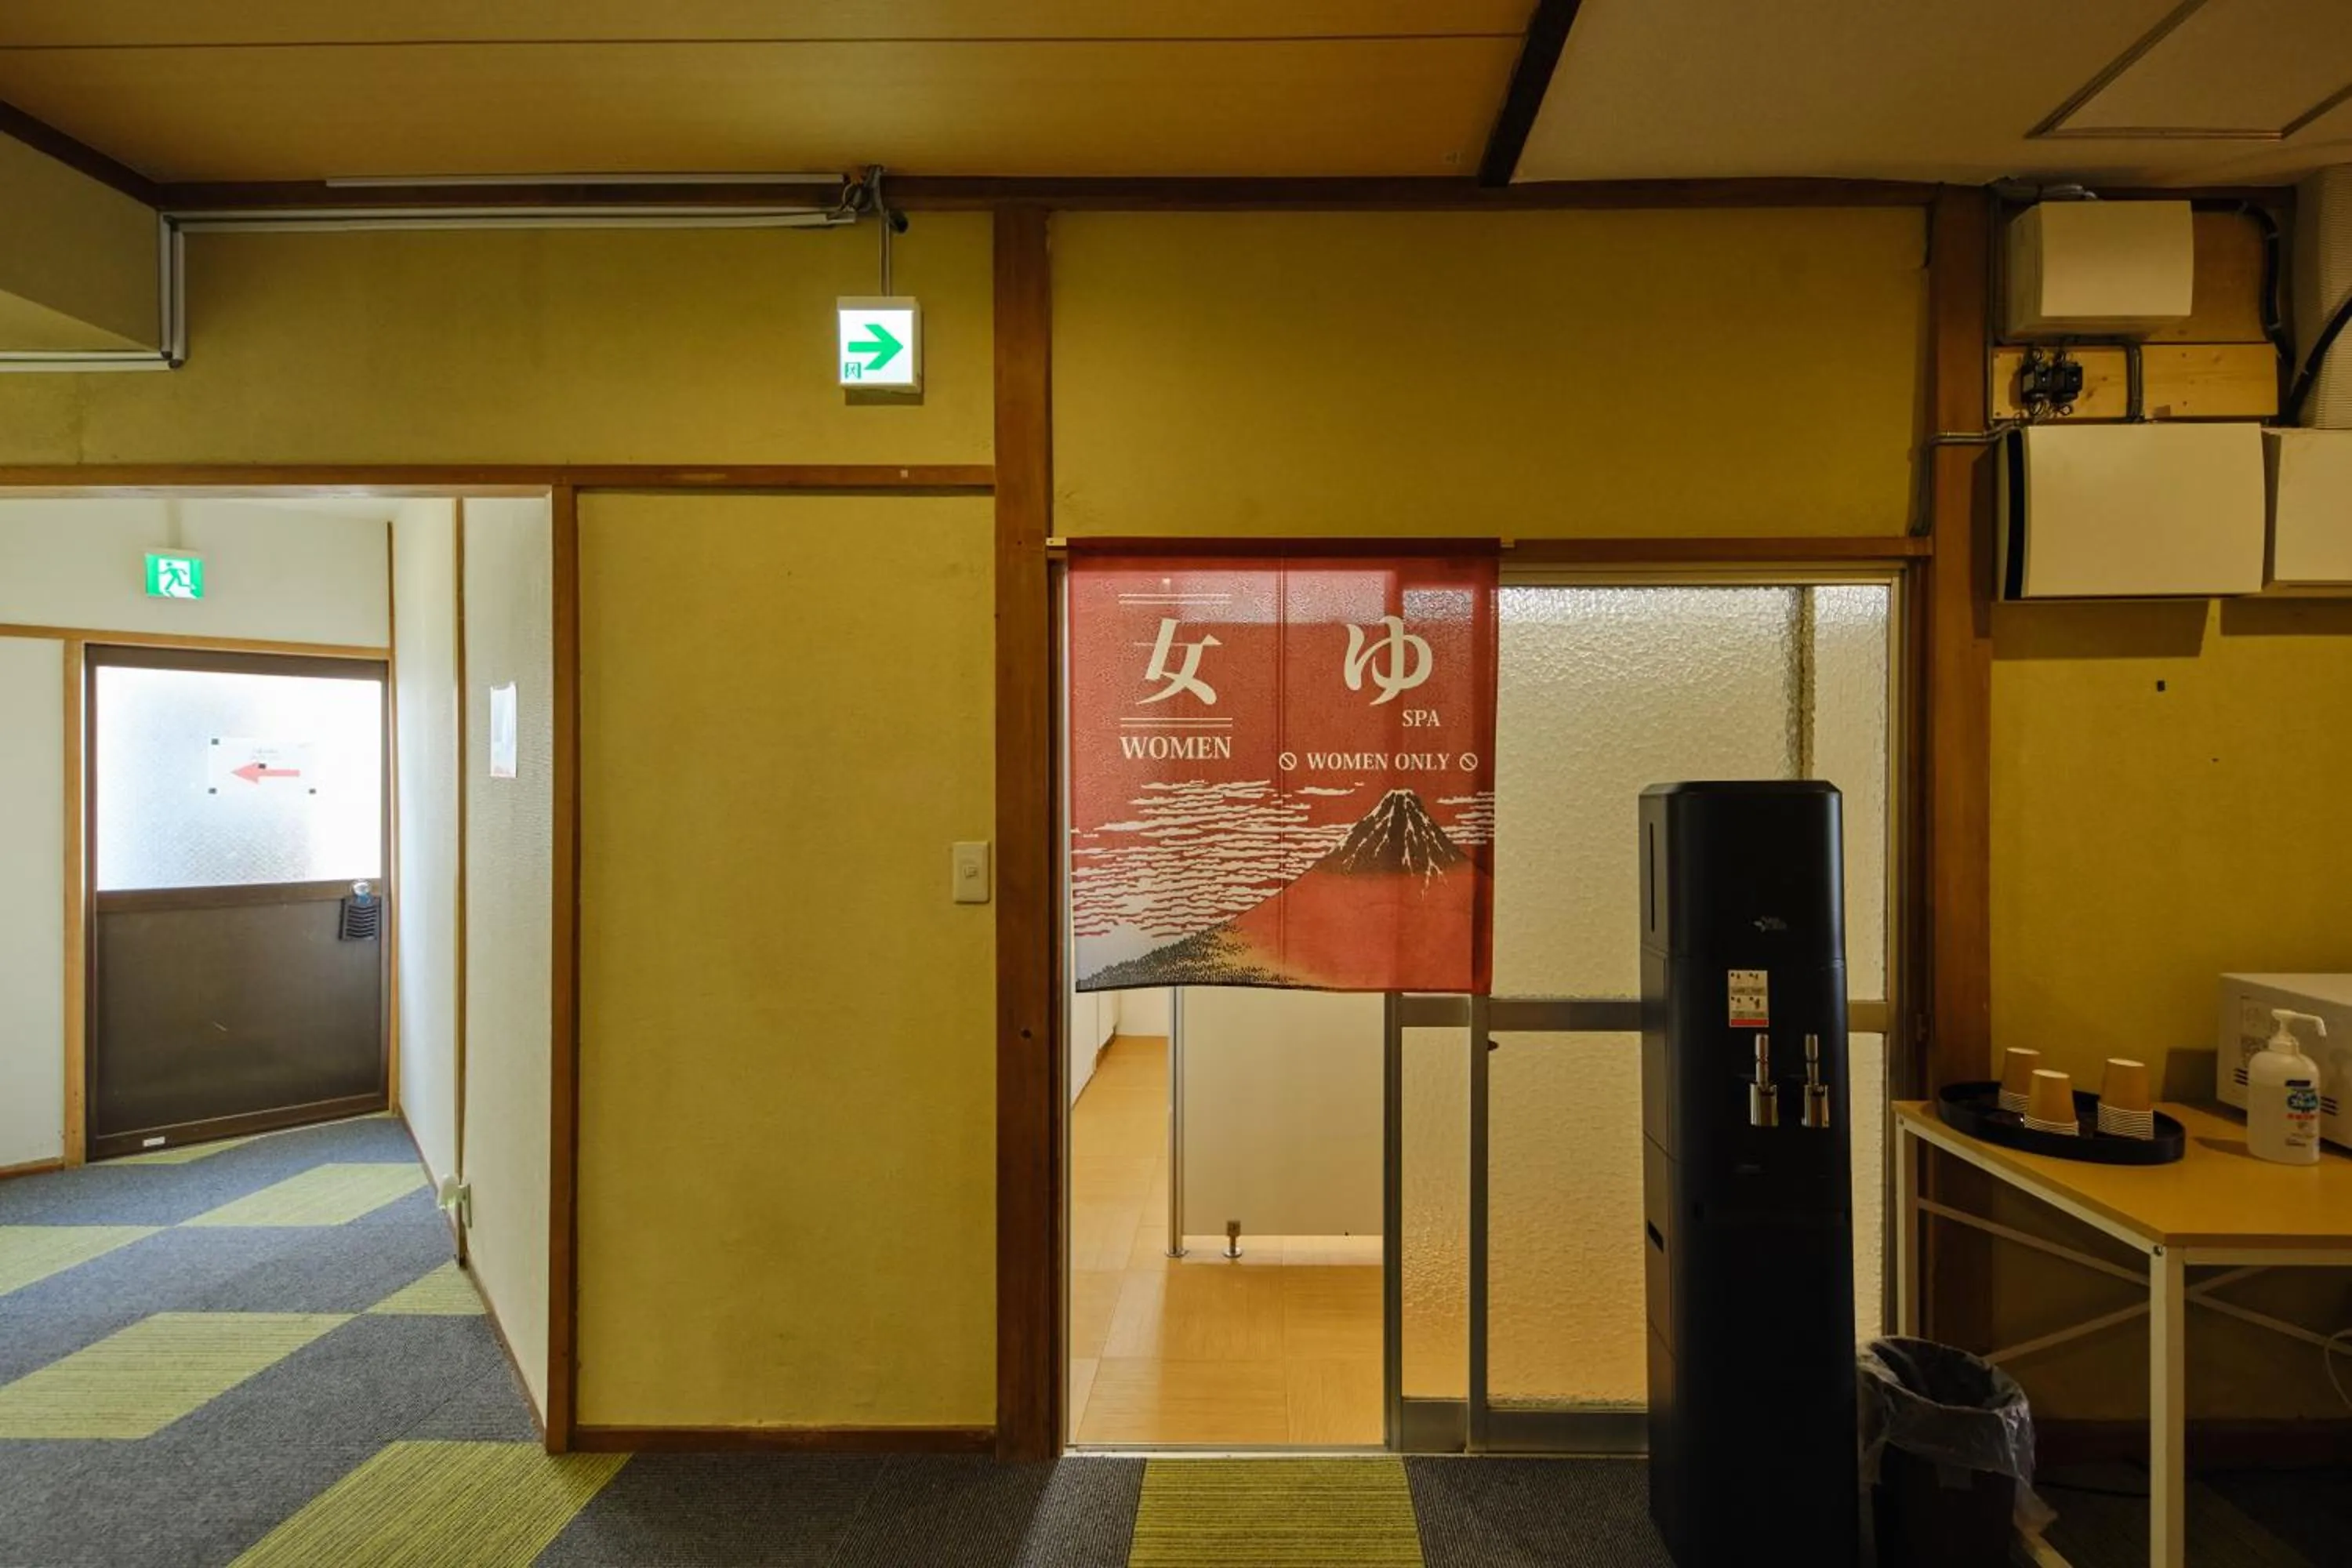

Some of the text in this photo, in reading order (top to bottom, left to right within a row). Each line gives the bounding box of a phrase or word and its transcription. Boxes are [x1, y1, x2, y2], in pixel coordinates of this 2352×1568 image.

[1132, 618, 1223, 706] 女
[1344, 615, 1433, 706] ゆ
[1403, 710, 1441, 727] SPA
[1119, 736, 1232, 760] WOMEN
[1307, 752, 1450, 770] WOMEN ONLY
